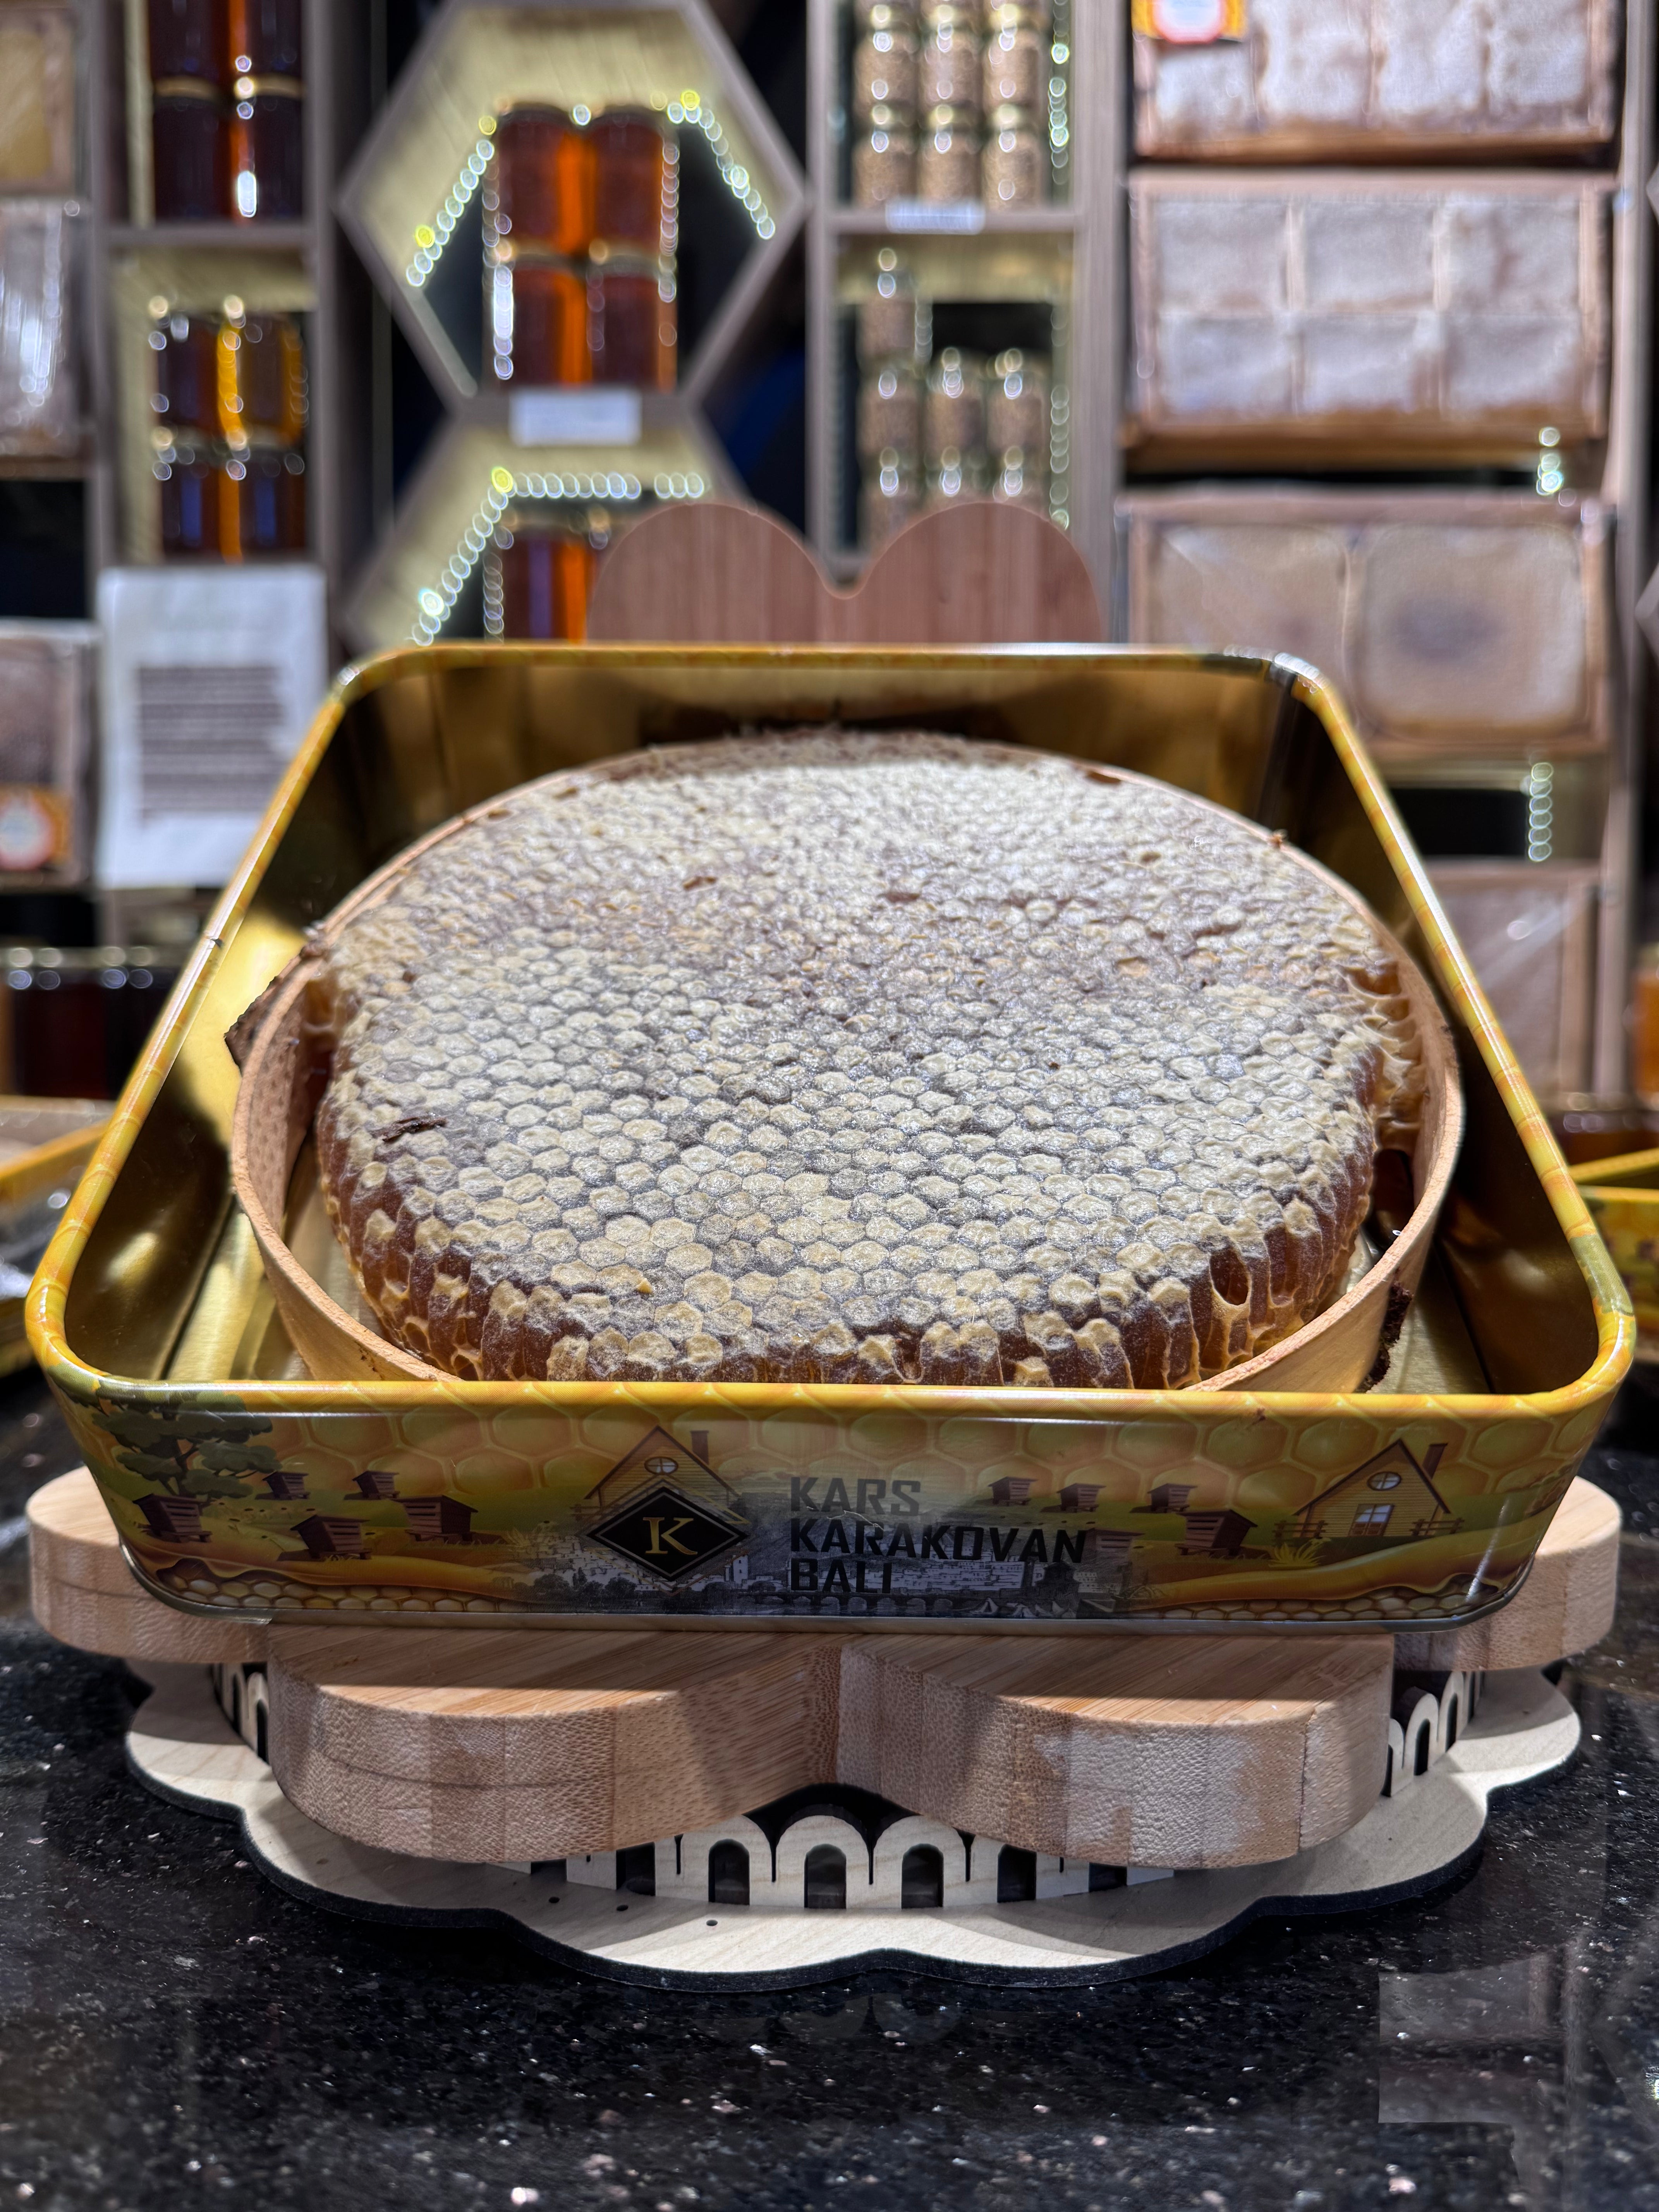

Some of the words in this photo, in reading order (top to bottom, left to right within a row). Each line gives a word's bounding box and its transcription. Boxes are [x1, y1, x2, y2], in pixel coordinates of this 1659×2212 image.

[791, 1477, 921, 1516] KARS
[642, 1517, 697, 1554] K
[790, 1518, 1085, 1563] KARAKOVAN
[791, 1558, 892, 1593] BALI
